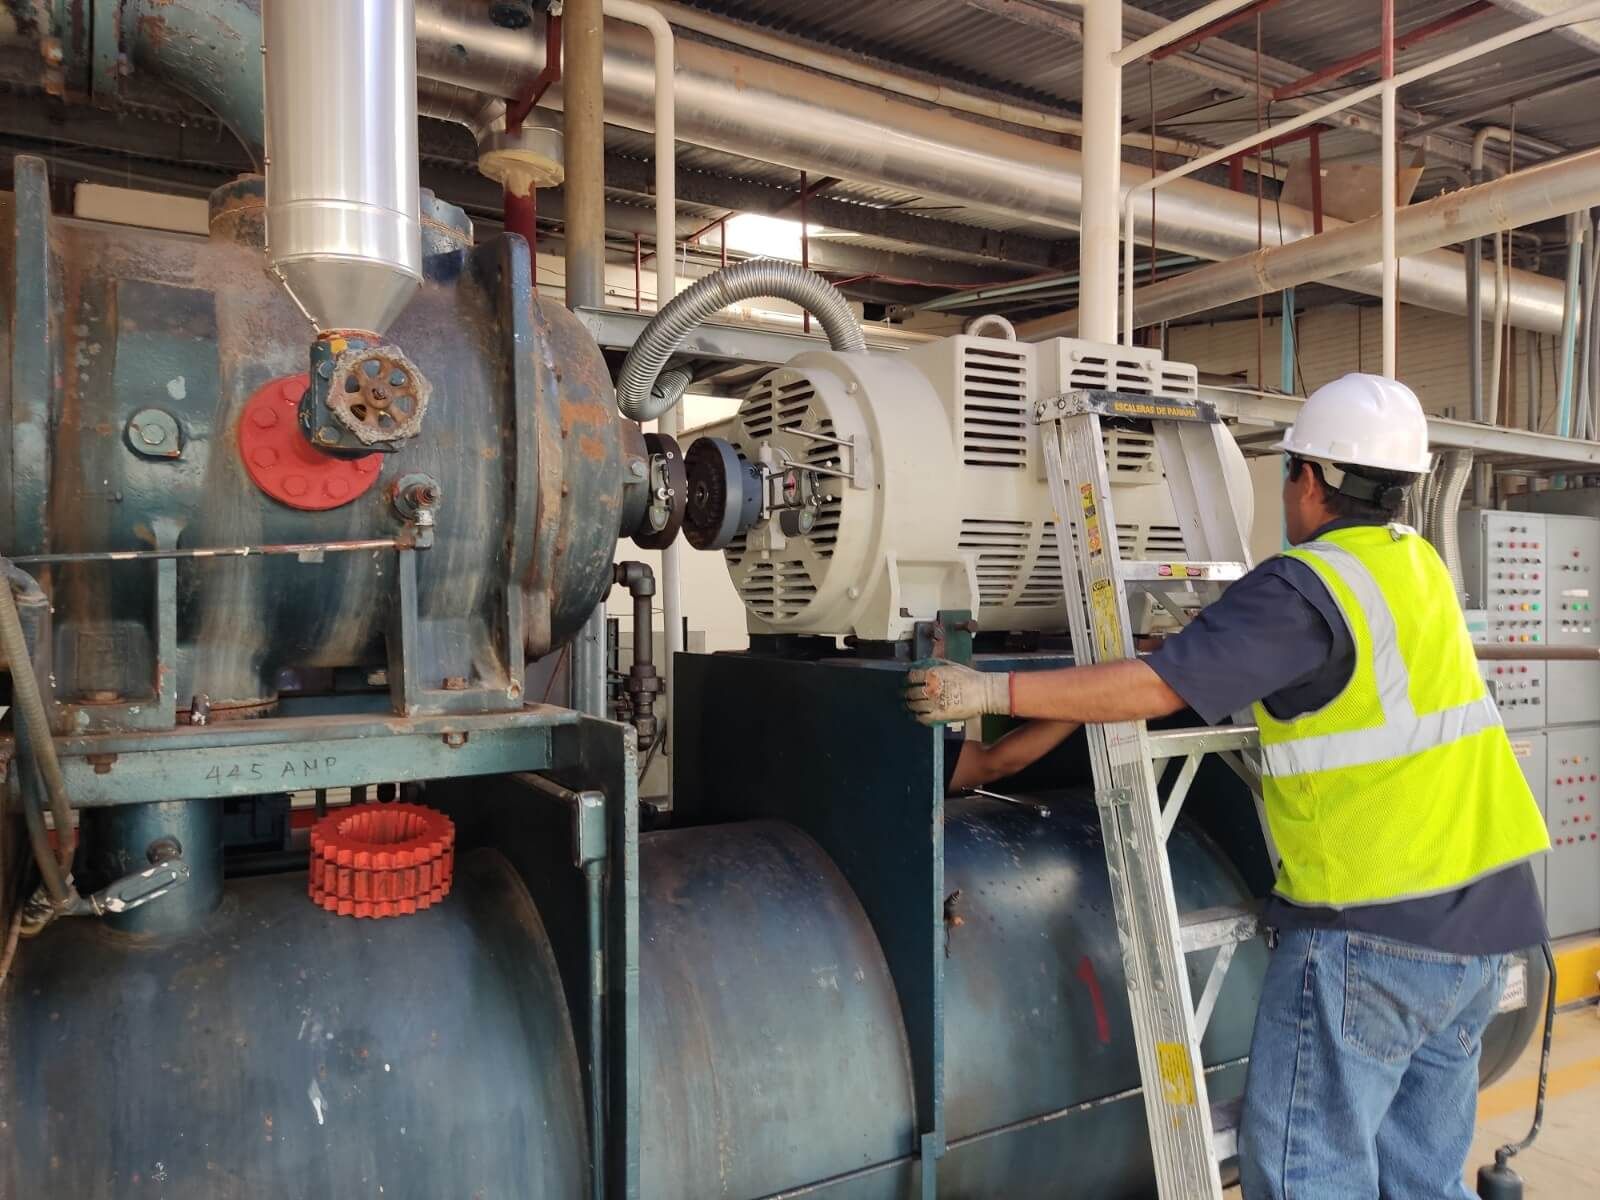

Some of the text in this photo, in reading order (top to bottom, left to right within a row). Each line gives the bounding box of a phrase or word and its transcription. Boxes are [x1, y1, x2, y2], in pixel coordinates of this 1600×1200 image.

[1114, 401, 1154, 415] ESCALERAS
[1156, 406, 1167, 415] DE
[205, 763, 263, 785] 445
